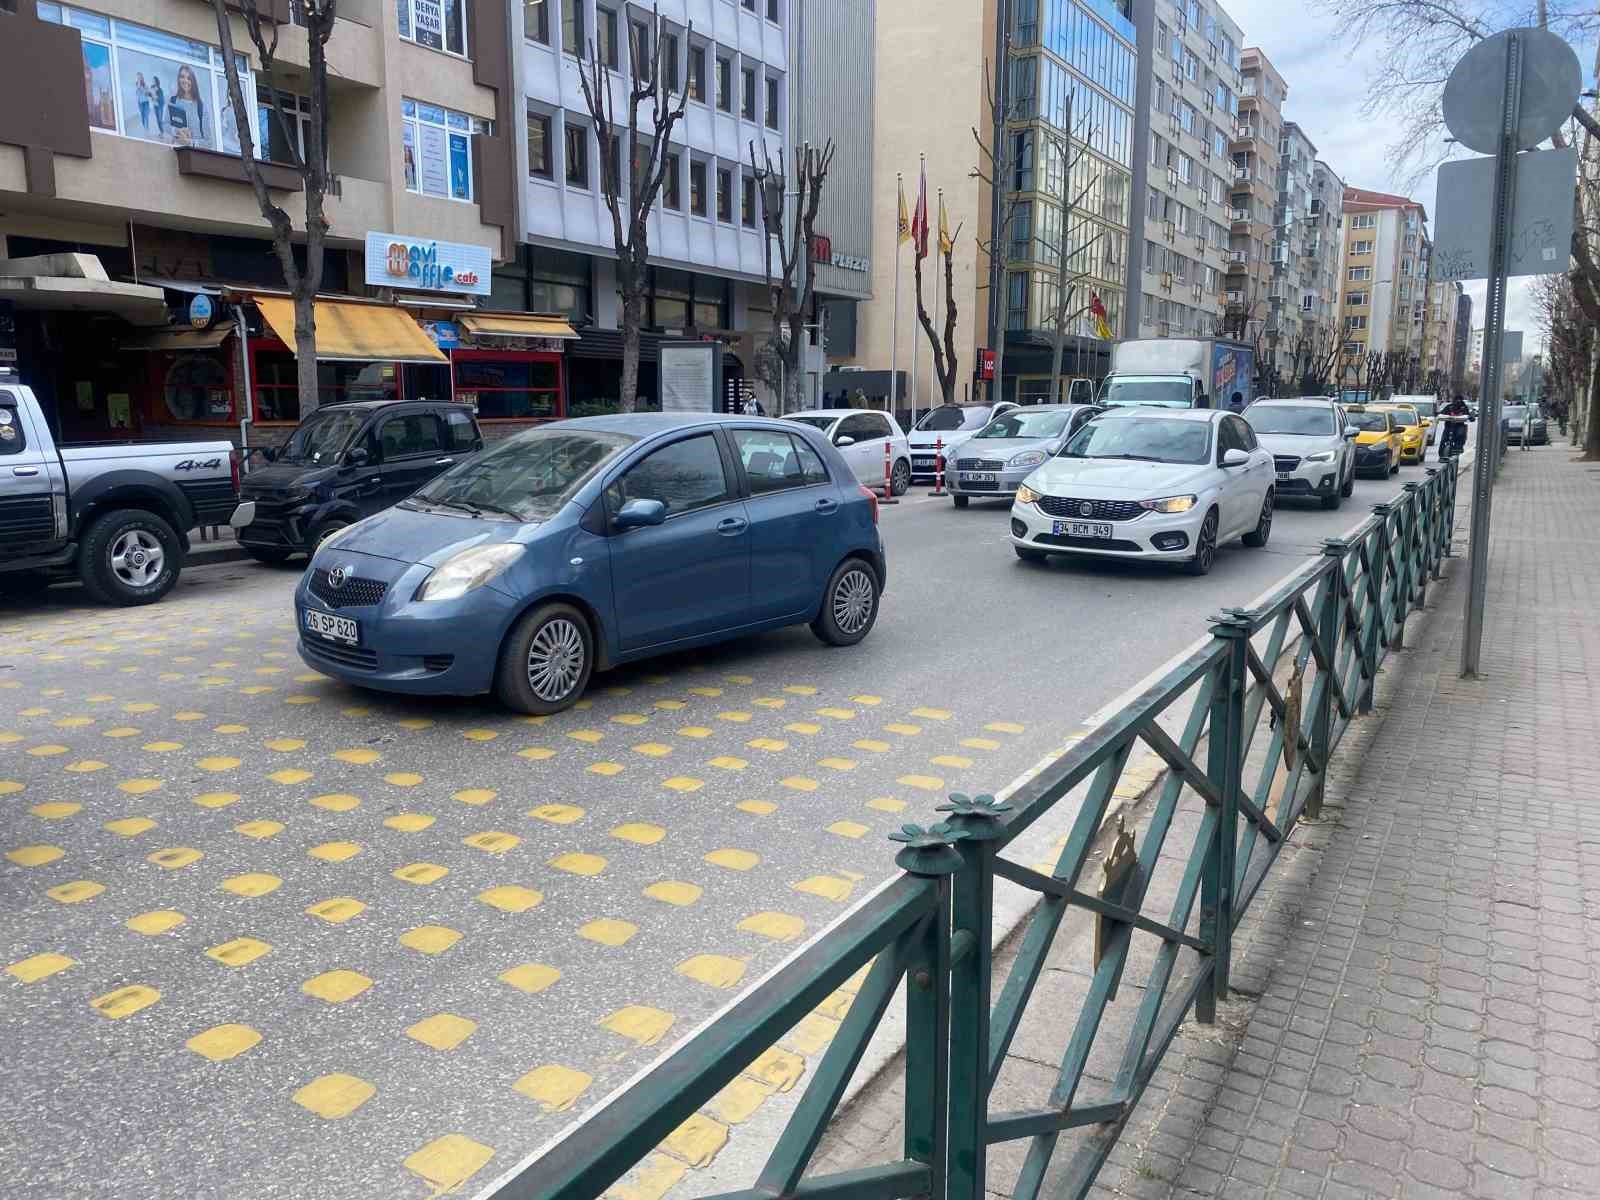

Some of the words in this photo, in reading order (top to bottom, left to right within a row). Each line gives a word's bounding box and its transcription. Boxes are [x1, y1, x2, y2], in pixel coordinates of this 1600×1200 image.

[415, 1, 440, 18] DERYA
[416, 13, 440, 30] YAŞAR
[831, 253, 870, 272] PLAZA
[456, 271, 479, 284] cafe
[174, 458, 221, 471] 4x4
[1059, 523, 1069, 532] 34
[307, 612, 319, 630] 26
[321, 616, 335, 632] SP
[337, 619, 356, 638] 620
